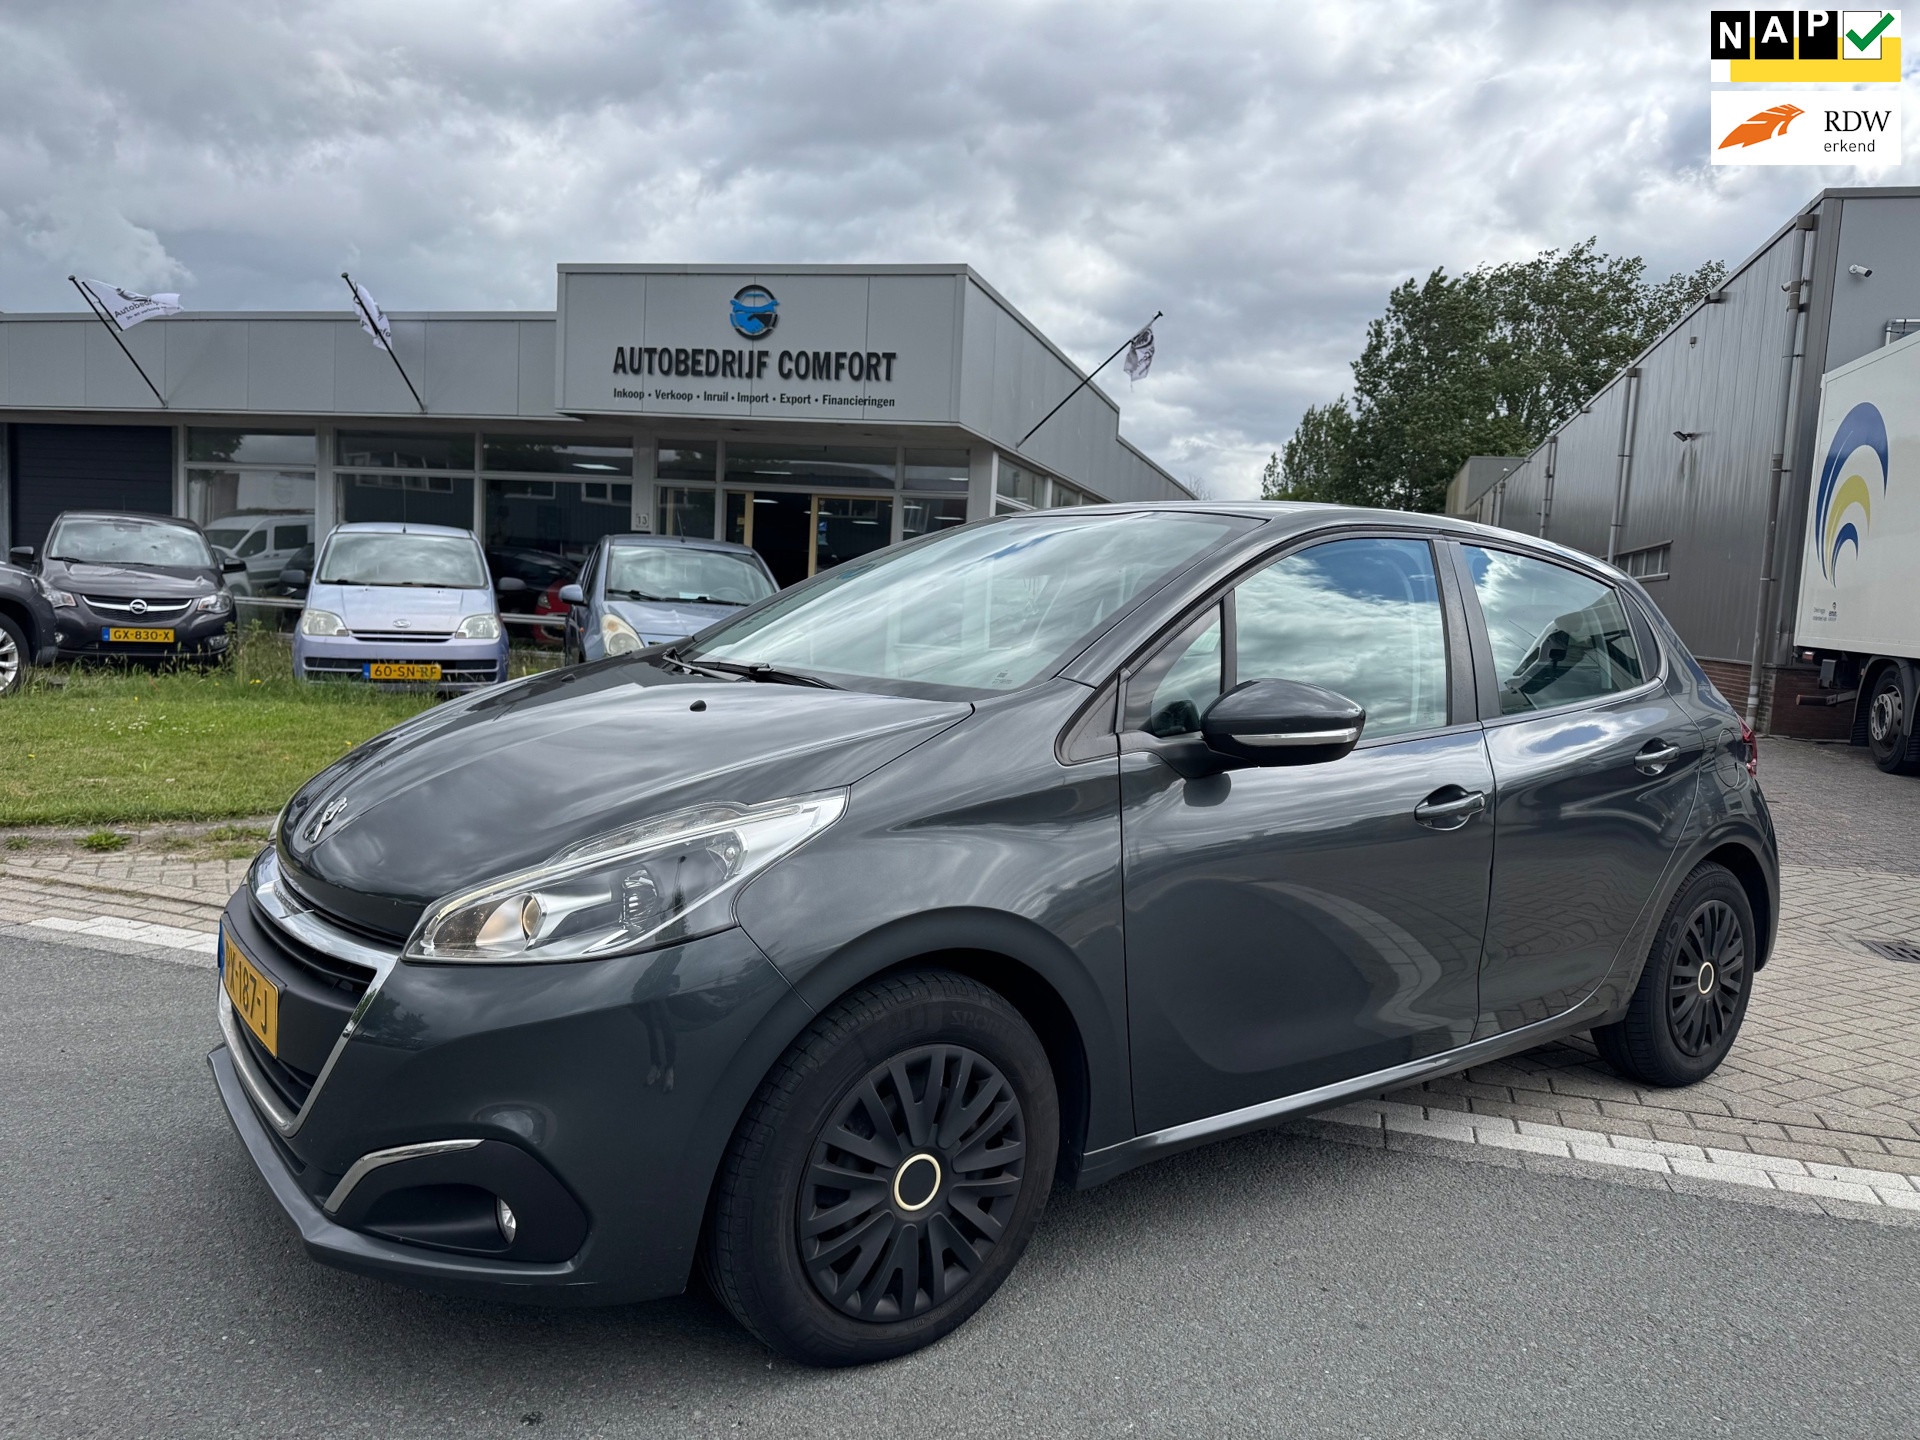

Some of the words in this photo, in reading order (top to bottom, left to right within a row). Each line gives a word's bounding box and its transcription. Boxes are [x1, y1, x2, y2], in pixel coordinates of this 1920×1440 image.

[613, 346, 769, 379] AUTOBEDRIJF
[778, 350, 897, 381] COMFORT
[613, 388, 644, 400] Inkoop
[655, 389, 693, 402] Verkoop
[704, 391, 728, 402] Inruil
[737, 392, 769, 404] Import
[780, 393, 811, 405] Export
[822, 394, 895, 408] Financieringen
[638, 515, 648, 525] 13
[114, 630, 170, 640] GX-830-X
